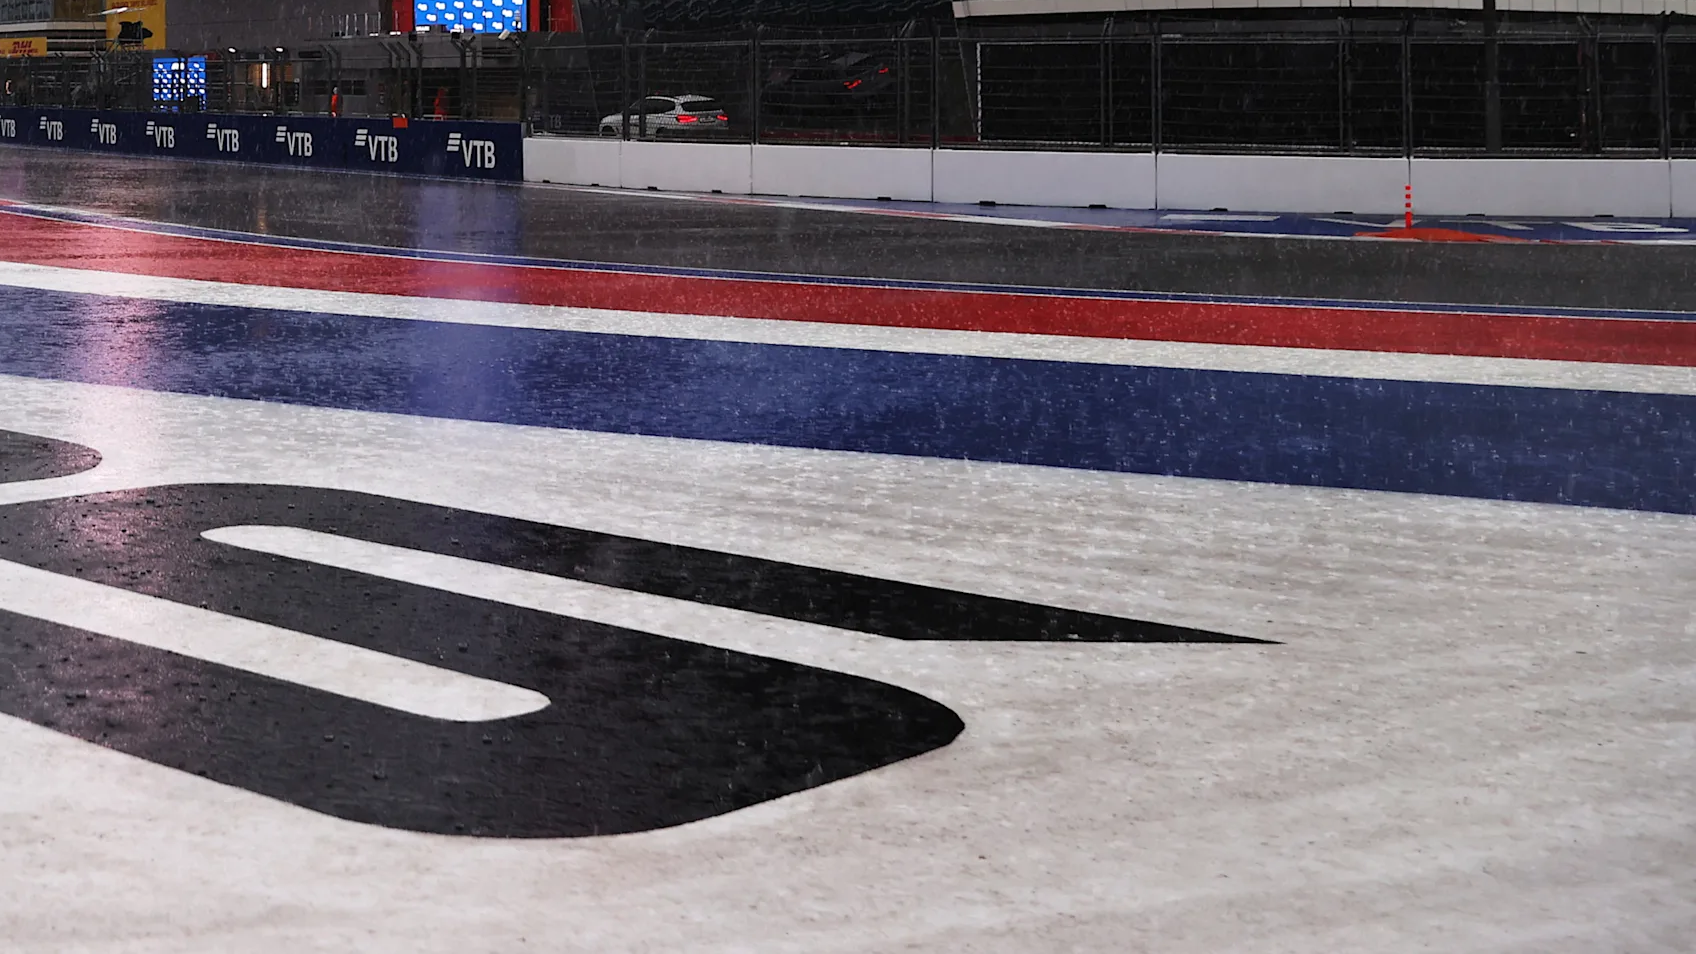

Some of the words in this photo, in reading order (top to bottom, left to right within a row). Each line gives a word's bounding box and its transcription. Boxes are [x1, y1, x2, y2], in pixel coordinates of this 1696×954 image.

[1, 119, 16, 138] VTB
[46, 121, 63, 140] VTB
[98, 124, 117, 144] VTB
[155, 127, 175, 148] VTB
[217, 129, 240, 152] VTB
[287, 132, 313, 157] VTB
[368, 135, 398, 163] VTB
[462, 140, 496, 169] VTB
